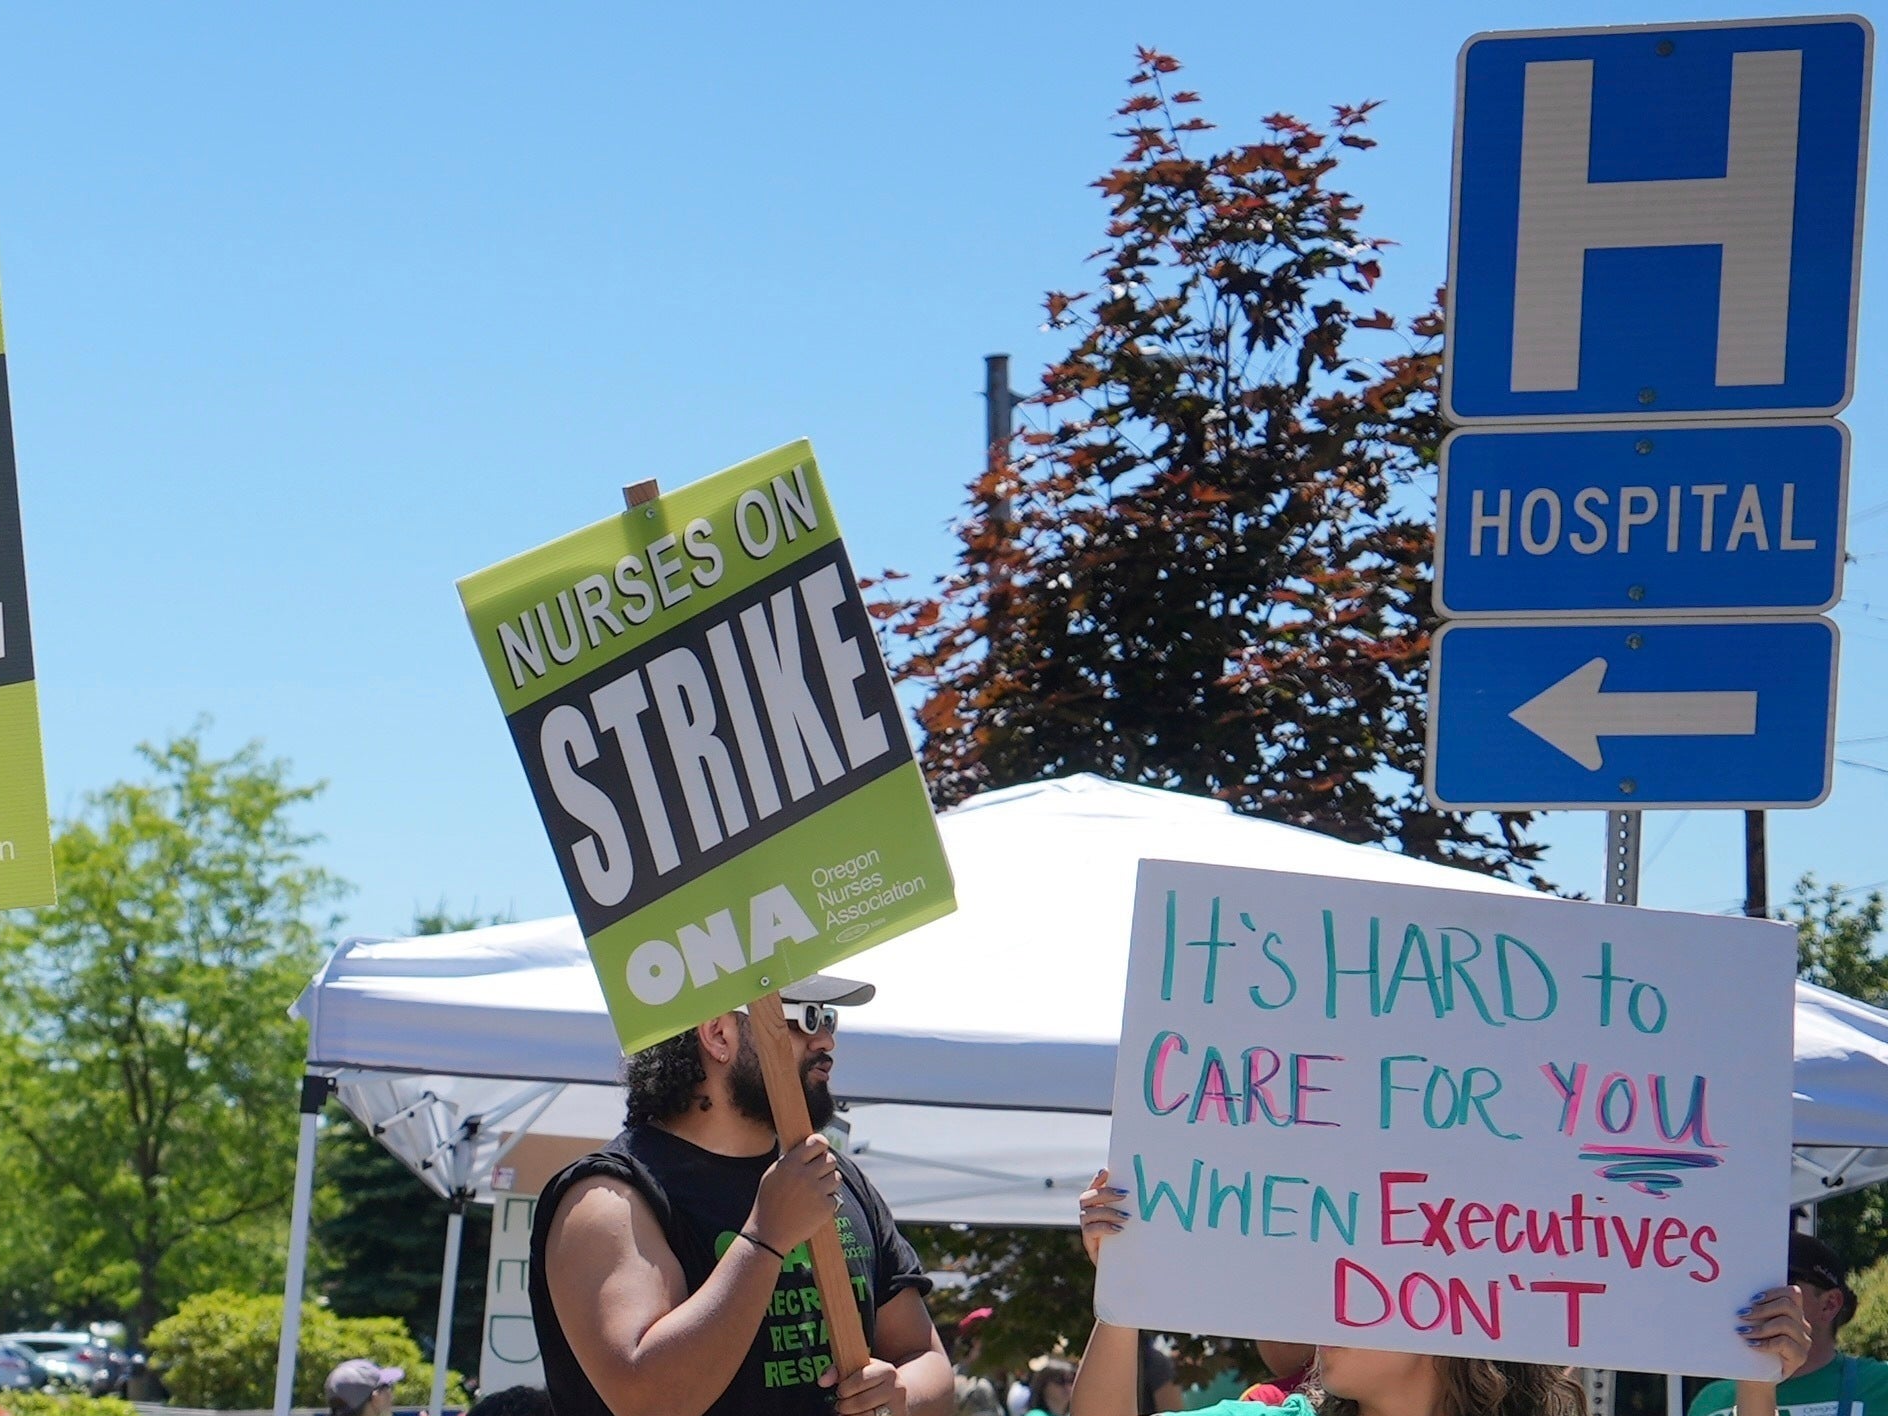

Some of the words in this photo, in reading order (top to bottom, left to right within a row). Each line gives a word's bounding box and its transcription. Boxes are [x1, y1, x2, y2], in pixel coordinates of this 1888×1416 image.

[1509, 48, 1804, 393] H
[496, 518, 724, 690] NURSES
[734, 465, 818, 559] ON
[1469, 482, 1817, 557] HOSPITAL
[539, 562, 890, 906] STRIKE
[812, 850, 880, 888] Oregon
[817, 872, 883, 910] Nurses
[826, 876, 926, 930] Association
[626, 883, 818, 1006] ONA
[1159, 890, 1297, 1010] It's
[1322, 909, 1559, 1027] HARD
[1582, 941, 1668, 1034] to
[1143, 1029, 1345, 1128] CARE
[1379, 1055, 1523, 1141] FOR
[1539, 1061, 1730, 1149] YOU
[1133, 1153, 1360, 1246] WHEN
[1379, 1171, 1721, 1283] Executives
[1334, 1257, 1607, 1348] DON'T
[763, 1354, 832, 1388] RESP
